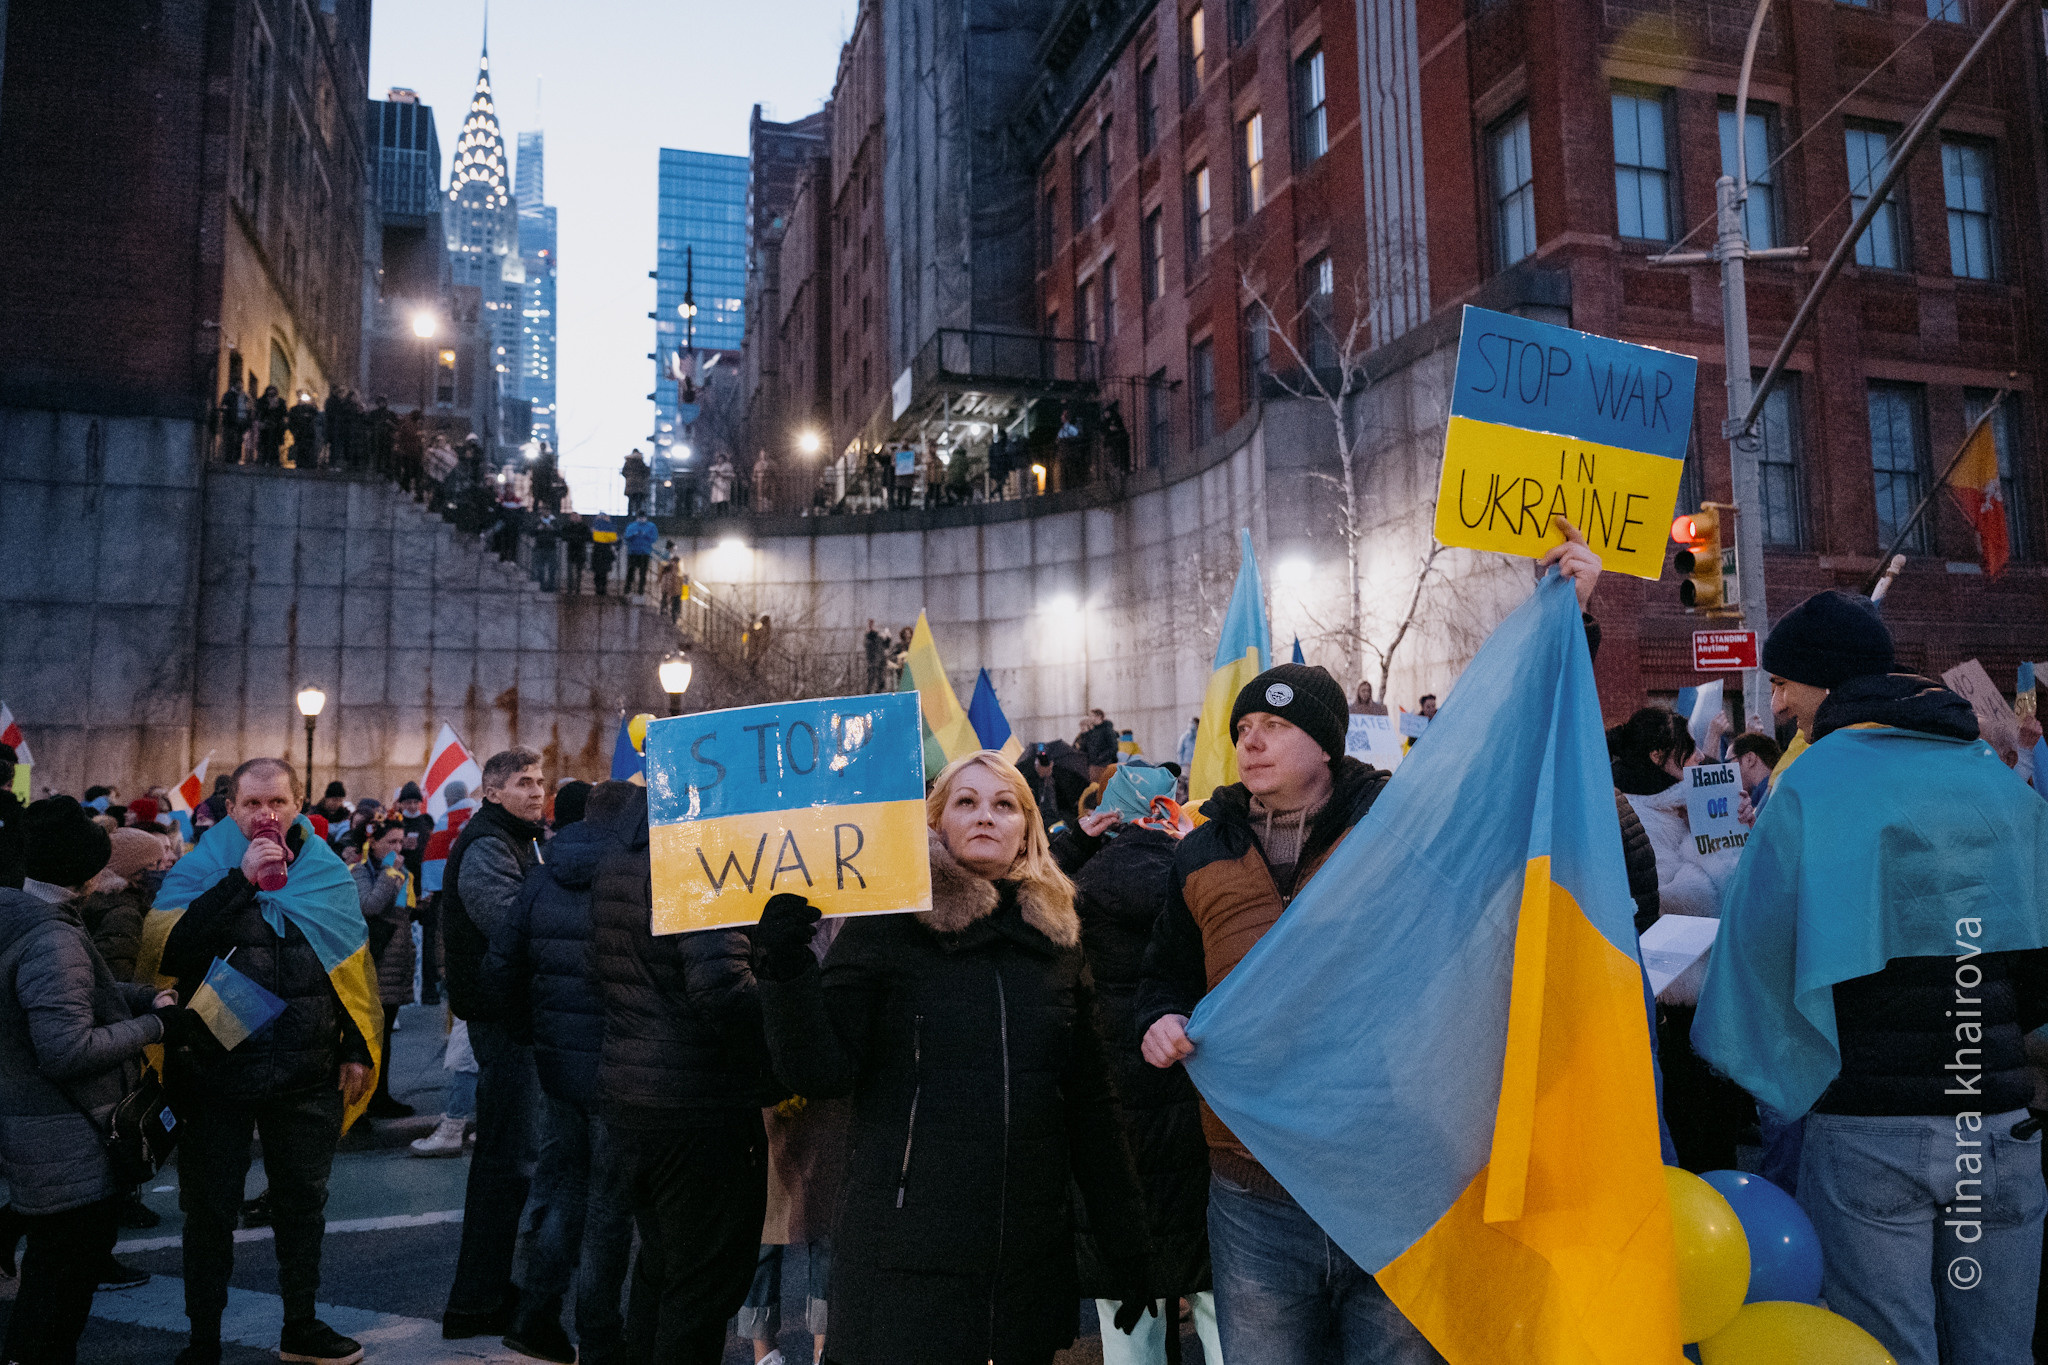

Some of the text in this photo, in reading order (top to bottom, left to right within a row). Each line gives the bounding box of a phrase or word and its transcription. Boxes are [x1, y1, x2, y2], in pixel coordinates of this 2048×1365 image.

[1471, 332, 1674, 433] STOP WAR
[1559, 450, 1596, 485] IN
[1458, 468, 1649, 553] UKRAINE
[1697, 634, 1748, 644] NO STANDING
[1697, 644, 1730, 653] Anytime
[1952, 674, 1974, 699] NO
[1349, 717, 1391, 731] NATE!
[684, 713, 874, 795] STOP
[1691, 765, 1735, 788] Hands
[1707, 796, 1729, 819] Off
[695, 823, 867, 897] WAR
